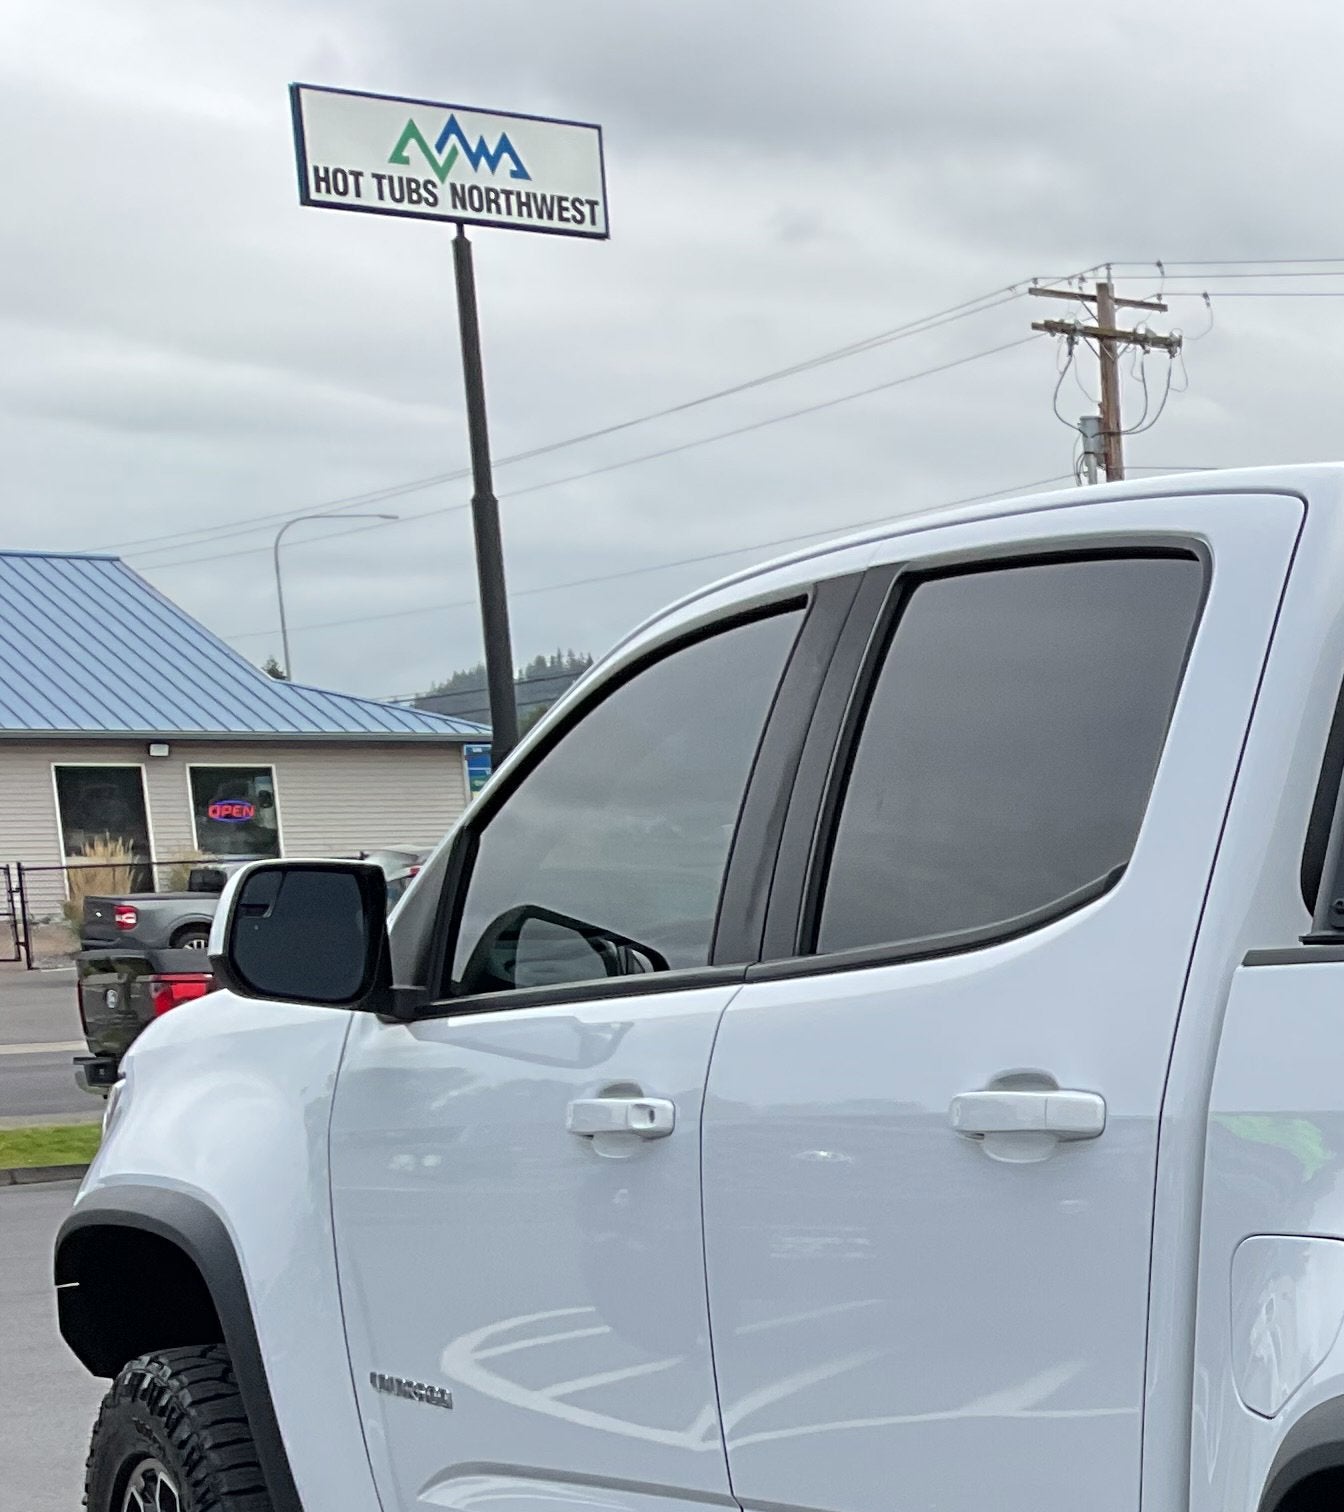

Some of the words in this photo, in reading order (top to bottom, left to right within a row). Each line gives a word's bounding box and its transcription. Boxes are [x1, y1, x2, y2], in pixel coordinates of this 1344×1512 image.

[313, 165, 363, 198] HOT
[371, 173, 438, 207] TUBS
[450, 182, 599, 226] NORTHWEST
[208, 804, 255, 819] OPEN
